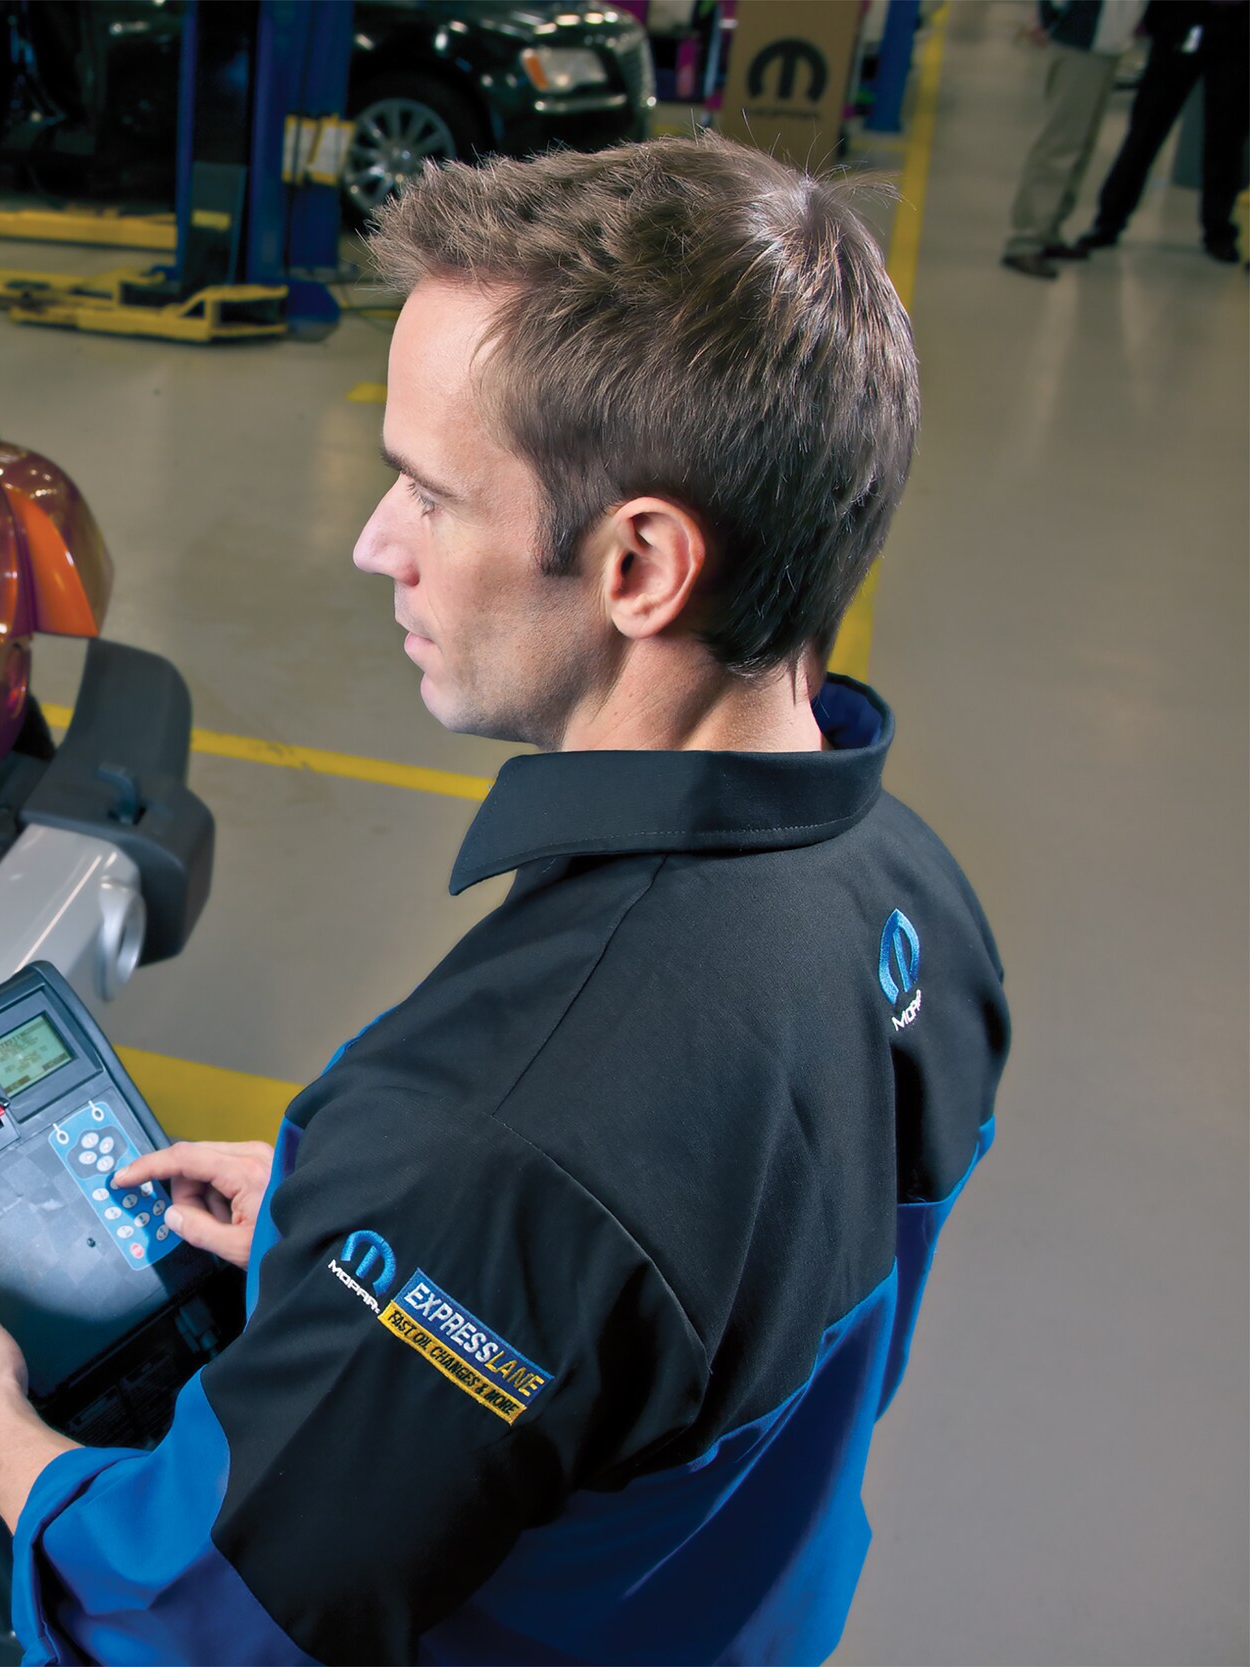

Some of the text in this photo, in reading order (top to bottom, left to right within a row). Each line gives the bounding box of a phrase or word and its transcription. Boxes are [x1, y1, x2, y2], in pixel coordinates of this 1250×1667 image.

[328, 1259, 380, 1313] MOPAR
[388, 1310, 520, 1416] FAST OIL CHANGES & MORE
